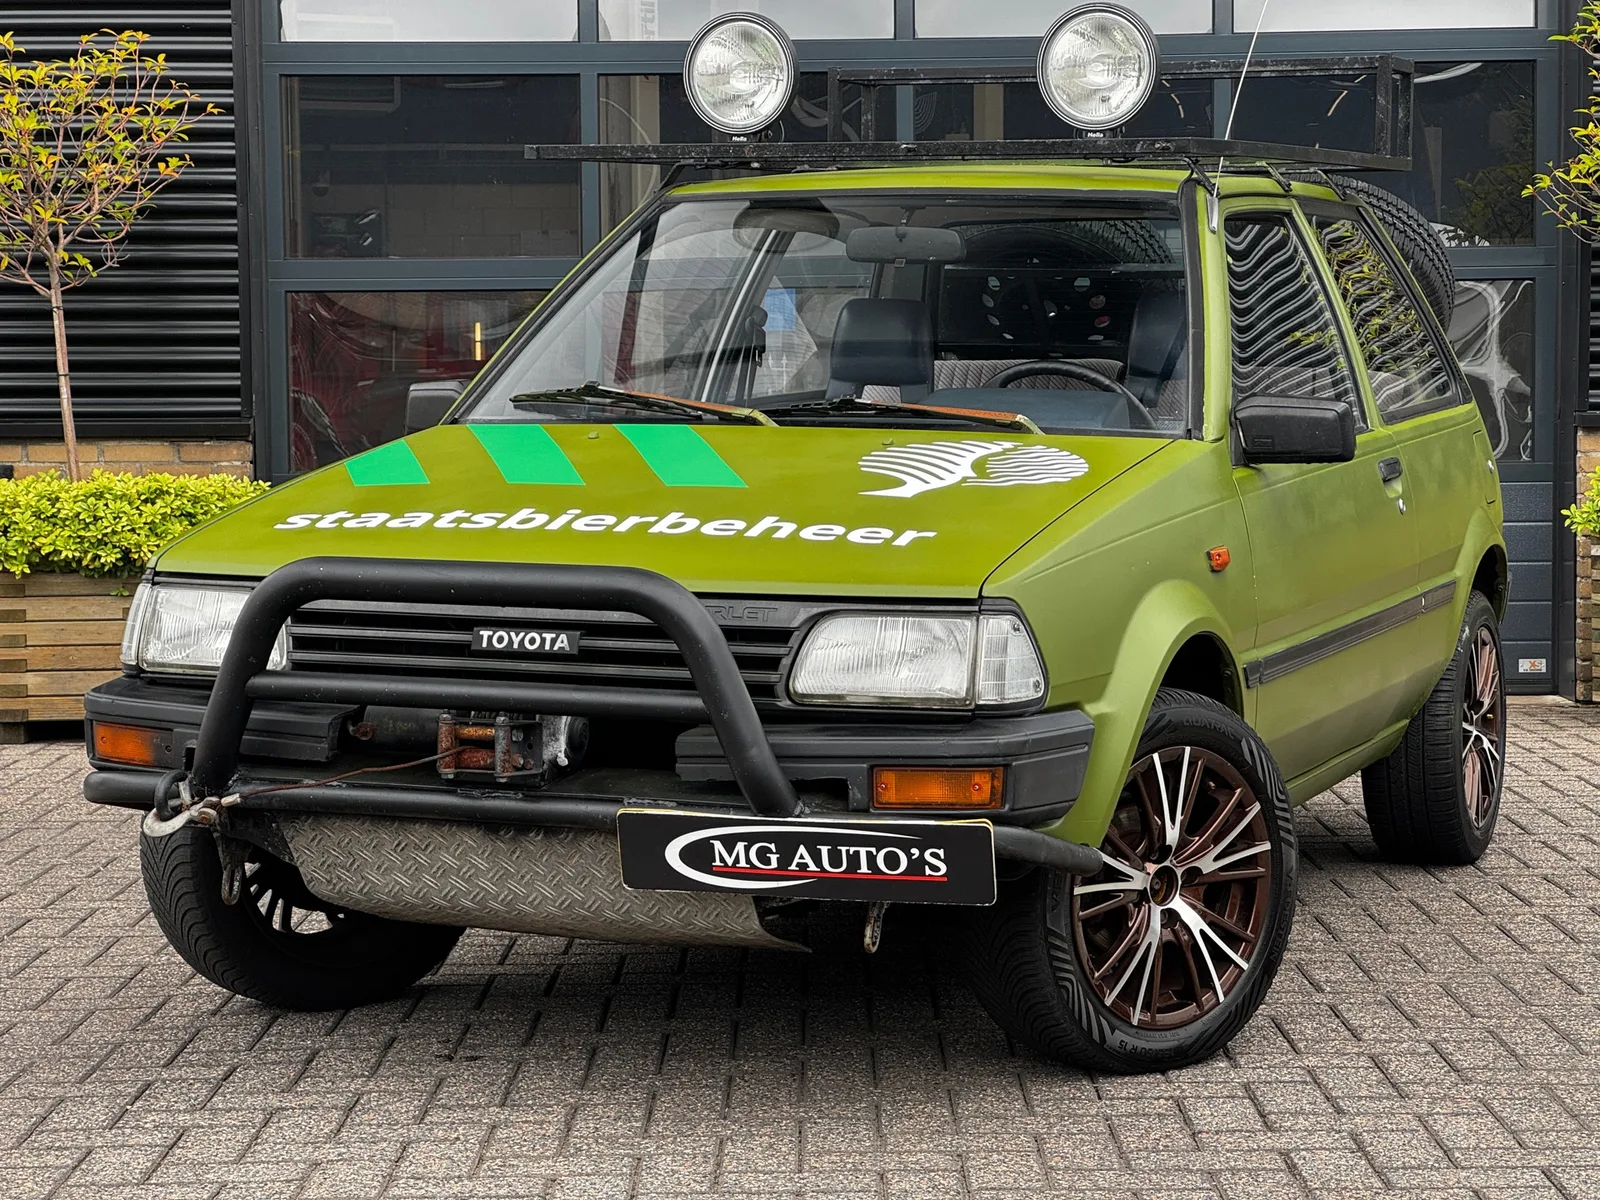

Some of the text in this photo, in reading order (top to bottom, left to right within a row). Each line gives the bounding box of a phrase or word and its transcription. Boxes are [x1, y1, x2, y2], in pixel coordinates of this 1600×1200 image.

[273, 507, 938, 547] staatsbierbeheer
[703, 604, 779, 623] RLET
[479, 630, 570, 651] TOYOTA
[709, 839, 948, 876] MG AUTO'S
[1118, 1039, 1129, 1051] 15
